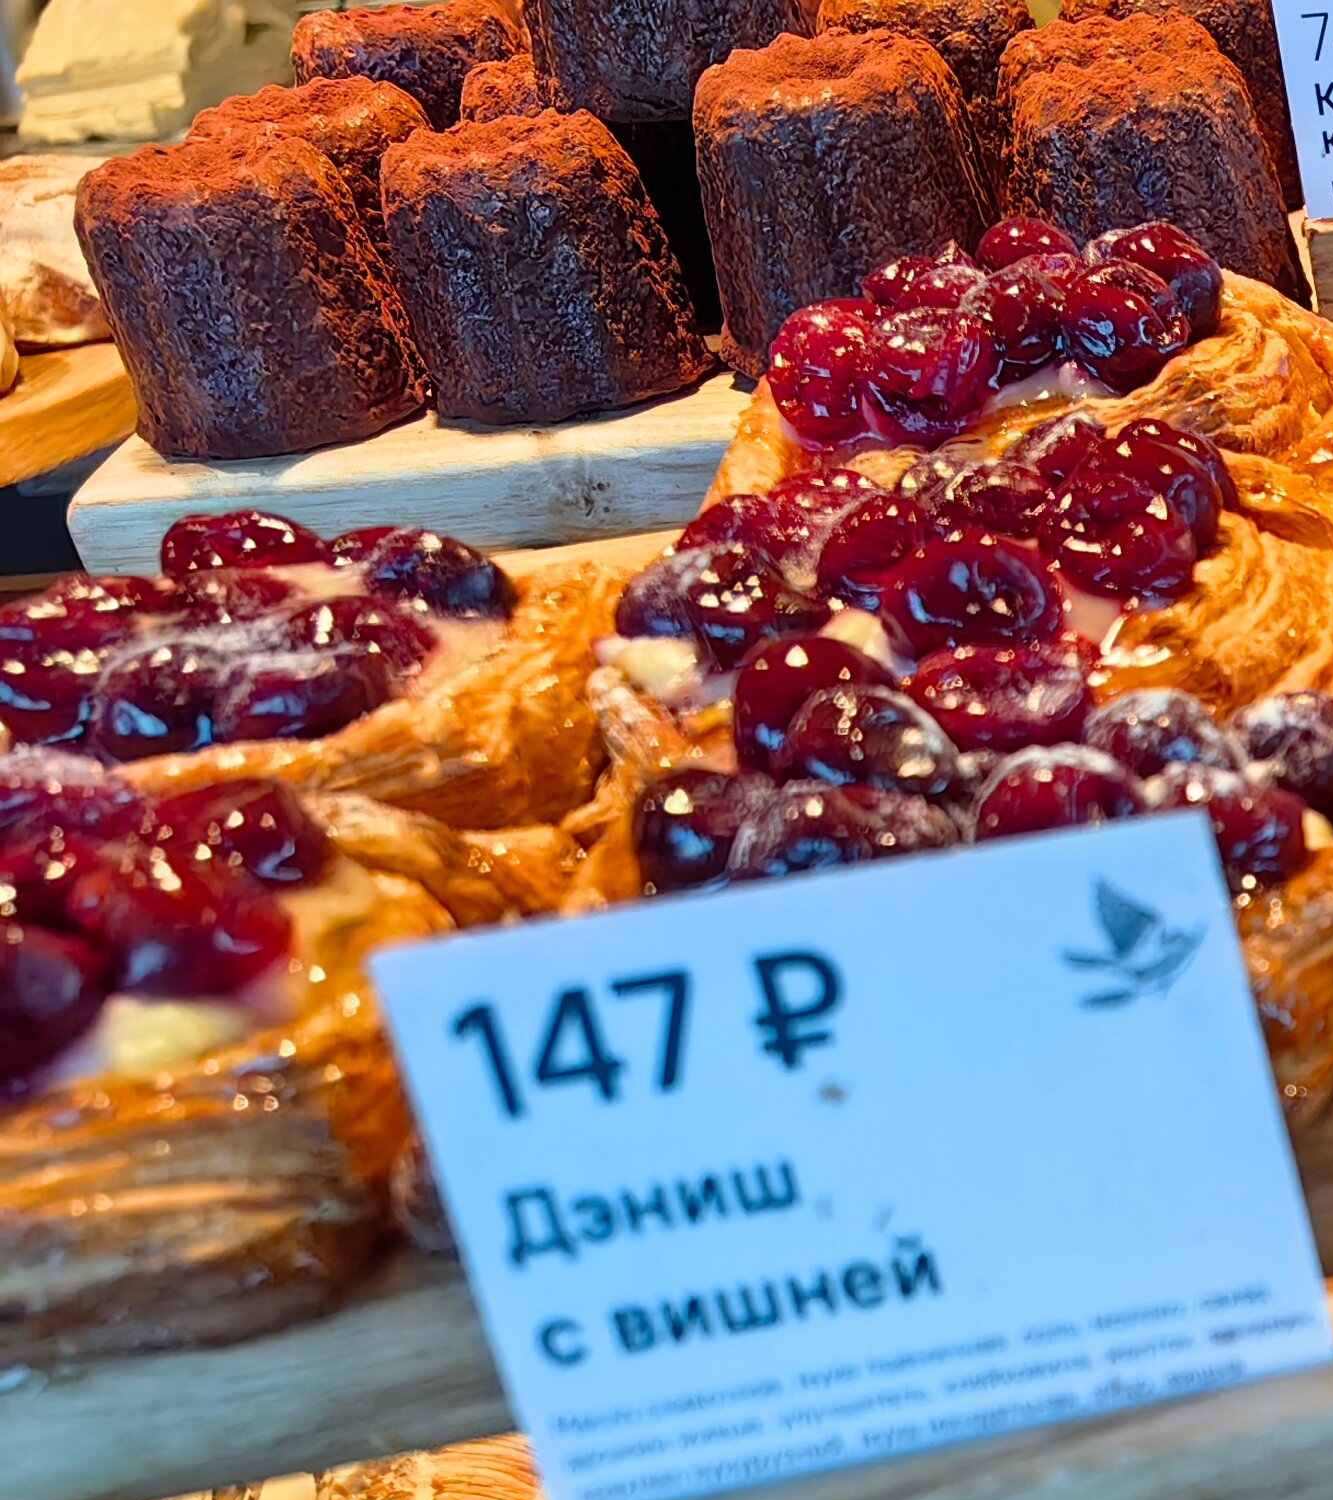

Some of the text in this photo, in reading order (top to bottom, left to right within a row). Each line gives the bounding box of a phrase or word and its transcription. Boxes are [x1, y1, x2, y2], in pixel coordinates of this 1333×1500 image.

[453, 948, 845, 1118] 147 ₽
[504, 1159, 801, 1266] Дэниш
[537, 1318, 588, 1367] с
[611, 1235, 942, 1355] вишней
